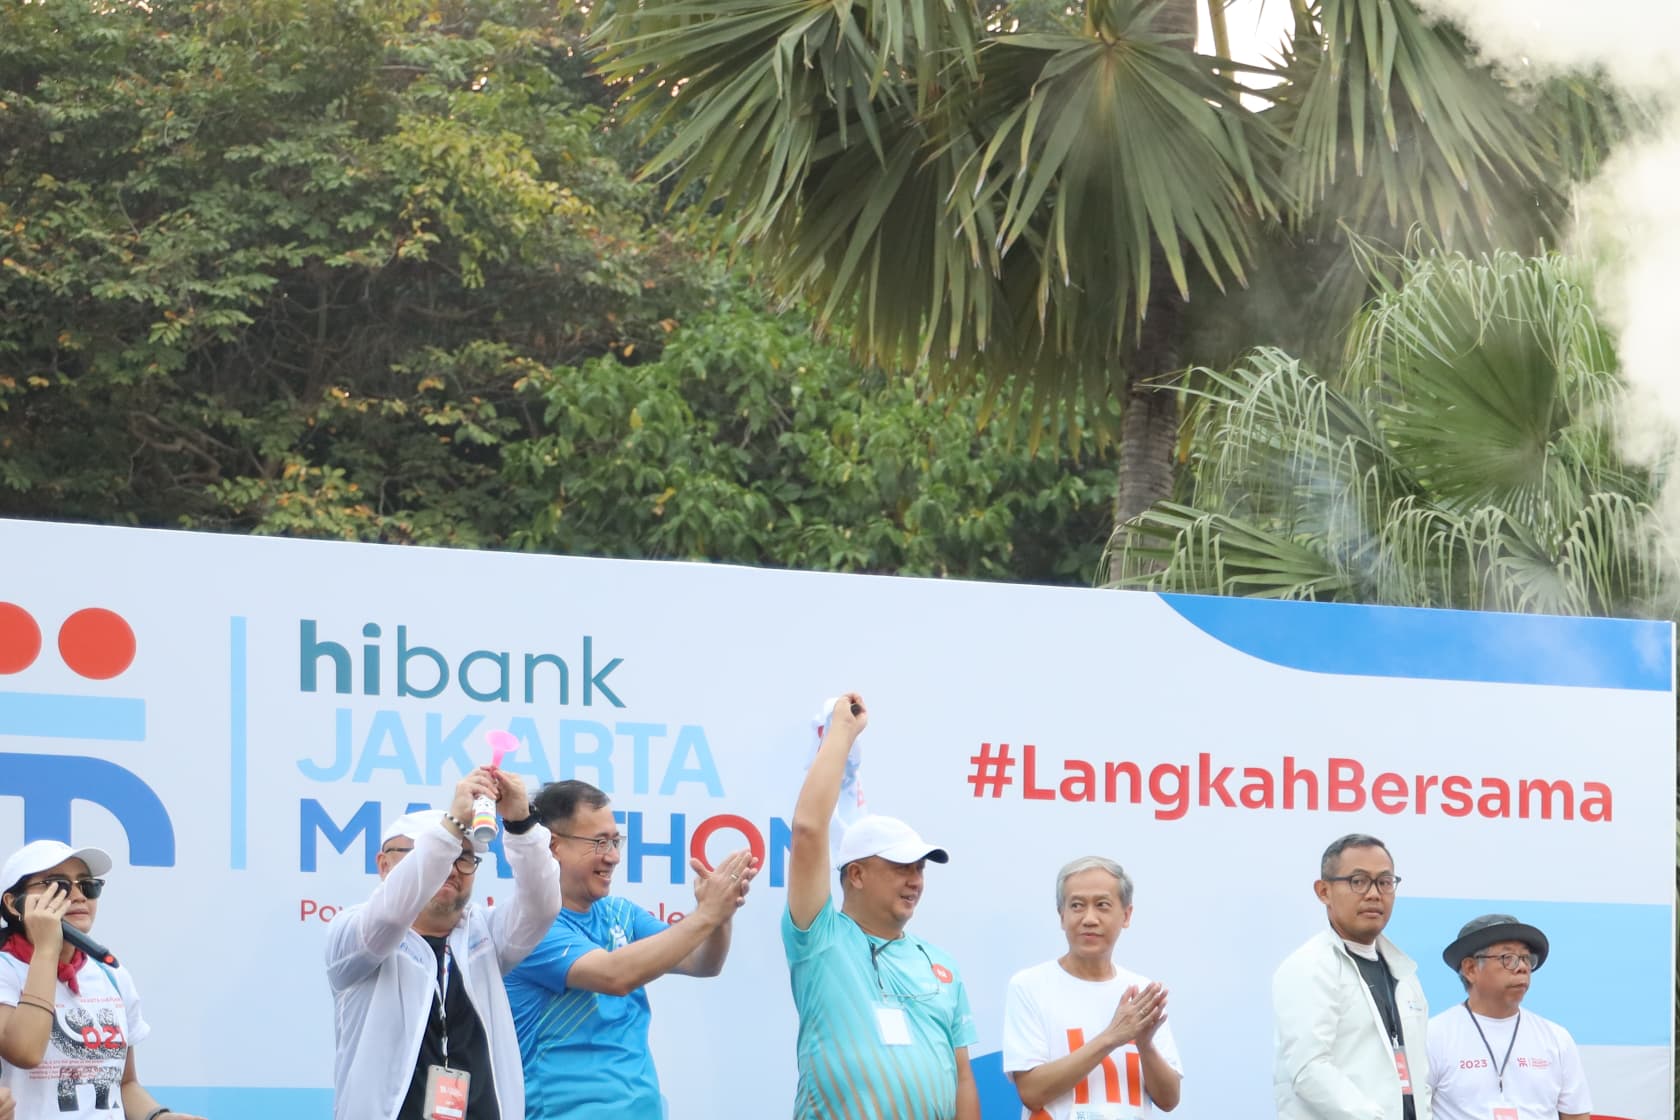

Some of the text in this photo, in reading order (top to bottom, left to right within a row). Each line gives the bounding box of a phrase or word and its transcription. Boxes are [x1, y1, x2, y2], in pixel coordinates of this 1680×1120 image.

[300, 618, 627, 709] hibank
[296, 706, 725, 798] JAKARTA
[967, 742, 1614, 823] #LangkahBersama
[1459, 1058, 1488, 1070] 2023
